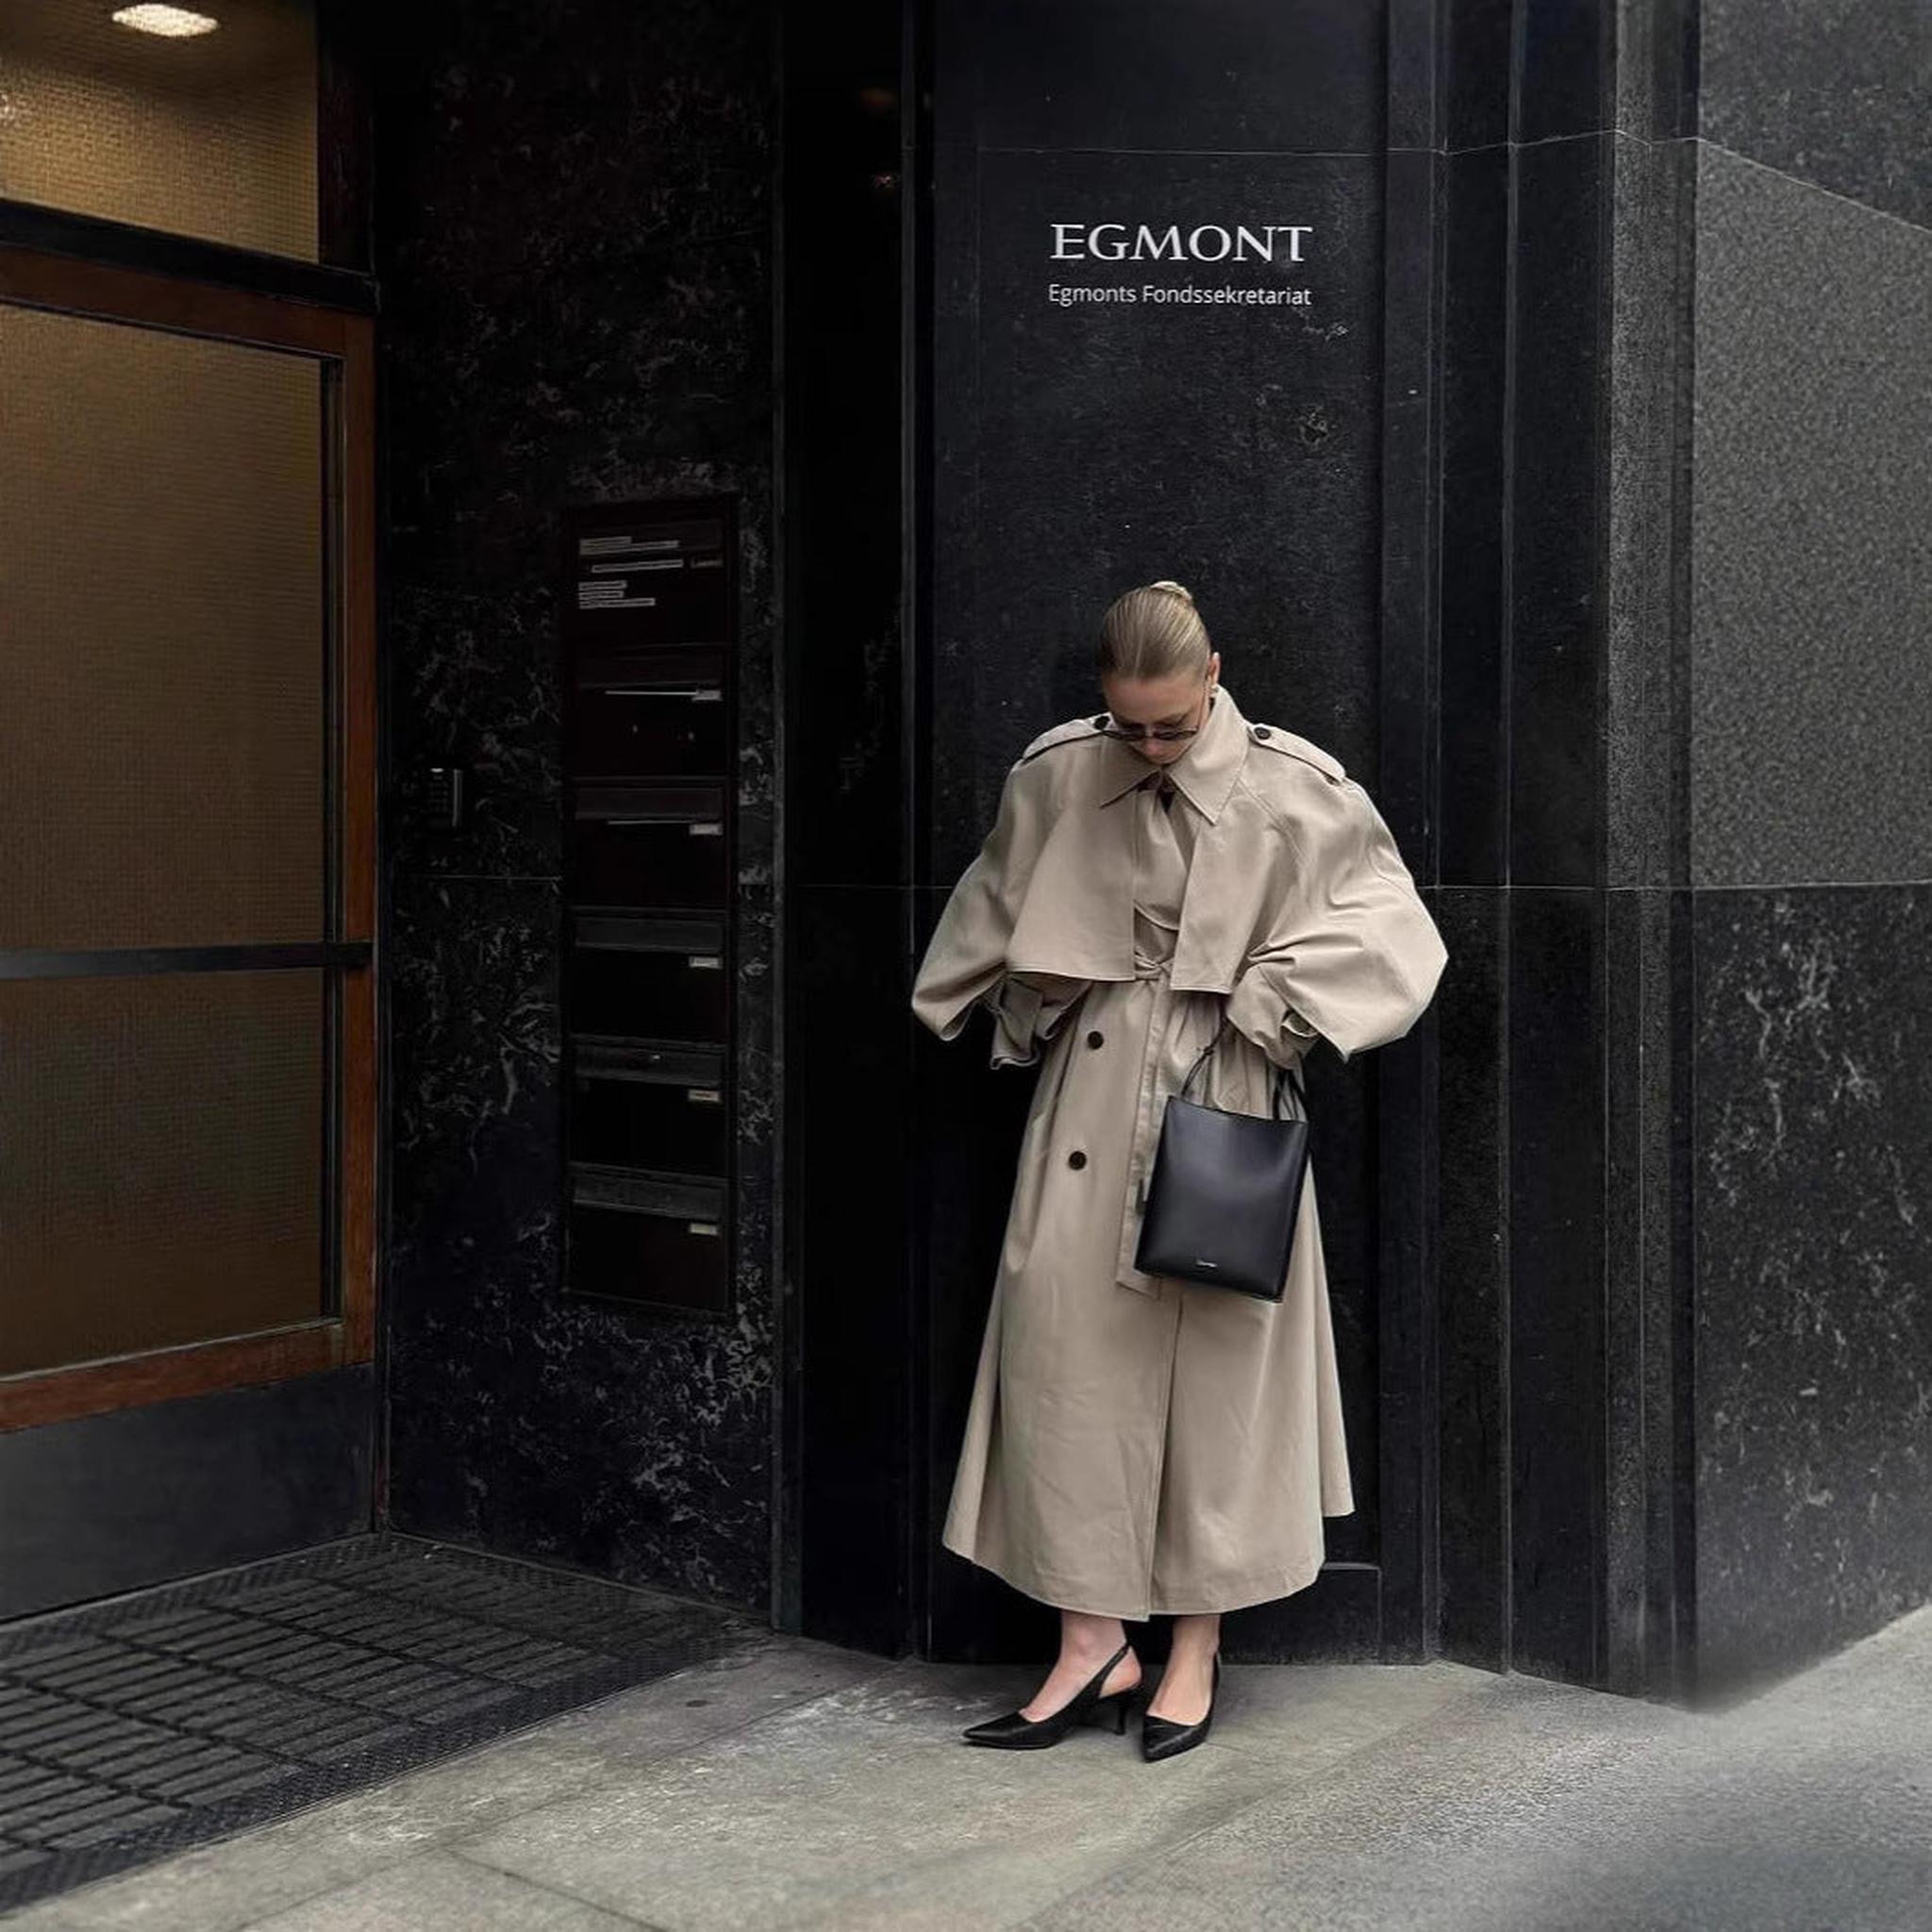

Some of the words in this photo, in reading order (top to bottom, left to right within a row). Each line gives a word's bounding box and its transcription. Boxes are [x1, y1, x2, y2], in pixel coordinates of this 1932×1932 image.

[1049, 223, 1314, 262] EGMONT
[1048, 283, 1138, 308] Egmonts
[1142, 284, 1312, 307] Fondssekretariat
